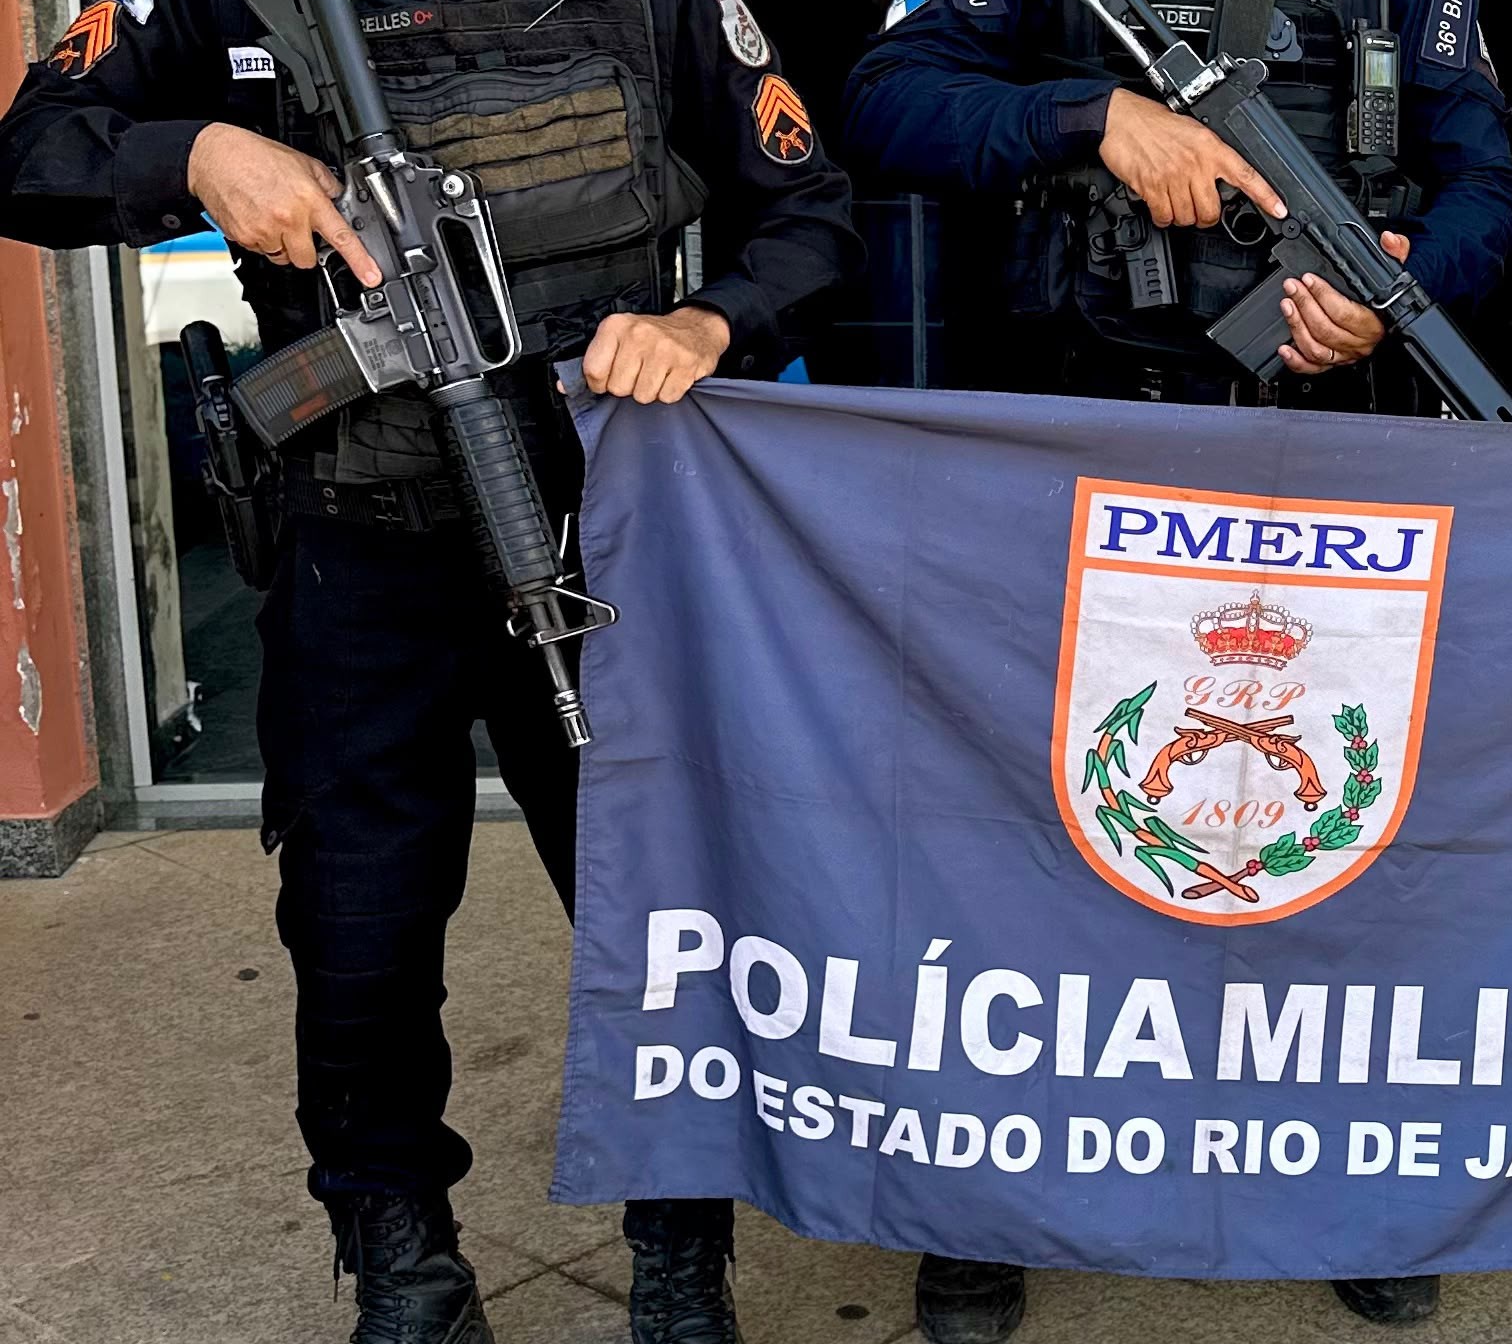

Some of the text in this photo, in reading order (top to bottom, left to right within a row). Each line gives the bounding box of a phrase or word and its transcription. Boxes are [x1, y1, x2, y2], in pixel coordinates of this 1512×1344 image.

[233, 57, 275, 73] MEIR
[1099, 504, 1424, 573] PMERJ
[1182, 674, 1307, 711] GRP
[1178, 798, 1287, 829] 1809
[642, 908, 1194, 1080] POLÍCIA
[633, 1044, 741, 1101] DO
[752, 1069, 1043, 1170] ESTADO
[1066, 1113, 1166, 1175] DO
[1191, 1118, 1321, 1176] RIO
[1346, 1120, 1443, 1177] DE
